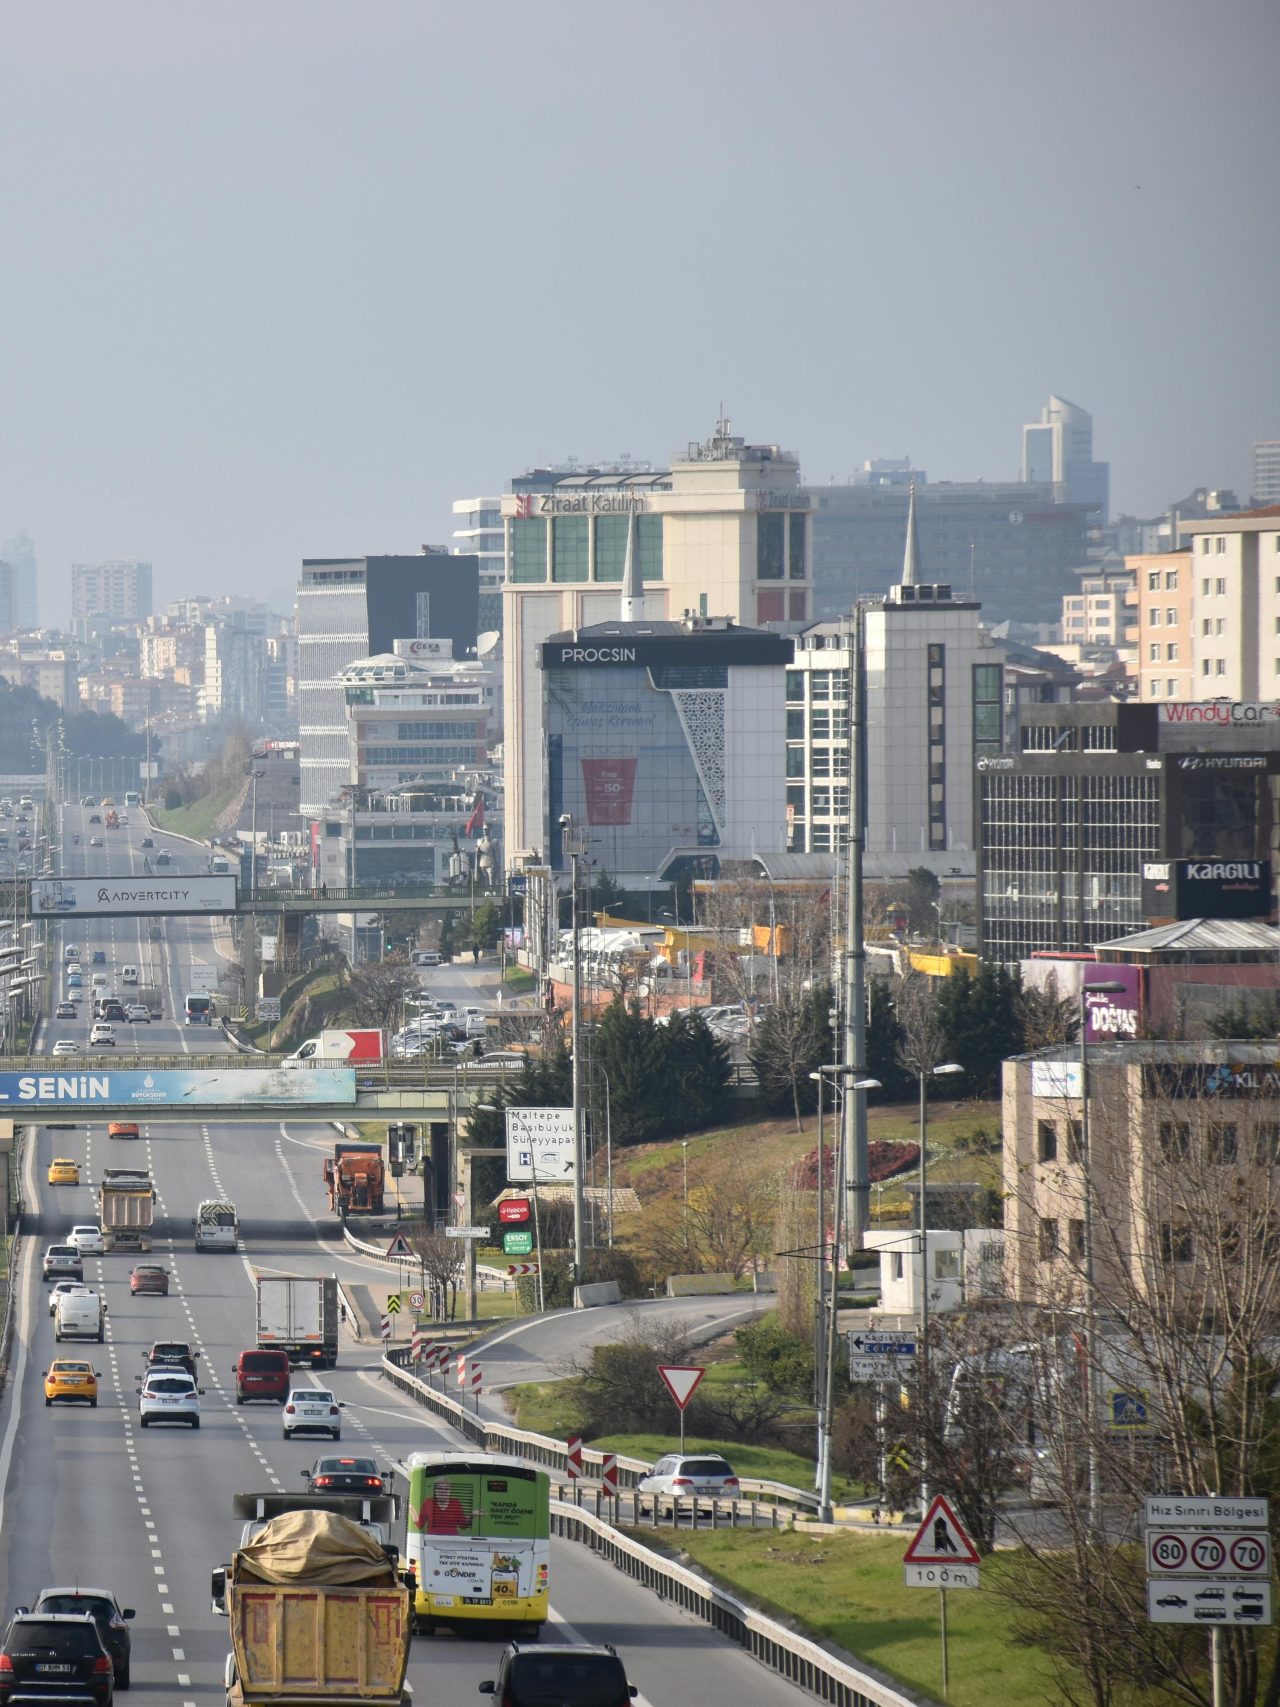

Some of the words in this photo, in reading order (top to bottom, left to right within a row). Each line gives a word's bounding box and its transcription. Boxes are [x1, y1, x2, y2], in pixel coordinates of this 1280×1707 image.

[540, 495, 587, 512] Ziraat
[562, 648, 636, 662] PROCSIN
[1205, 757, 1268, 769] HYUNDAI
[112, 890, 189, 901] ADVERTCITY
[512, 1111, 560, 1121] Maltepe
[412, 1296, 422, 1304] 30
[1151, 1505, 1172, 1515] Hız
[1214, 1506, 1264, 1518] Bölgesi
[1159, 1543, 1180, 1560] 80
[1198, 1545, 1220, 1562] 70
[1237, 1546, 1259, 1563] 70
[494, 1585, 509, 1594] 40
